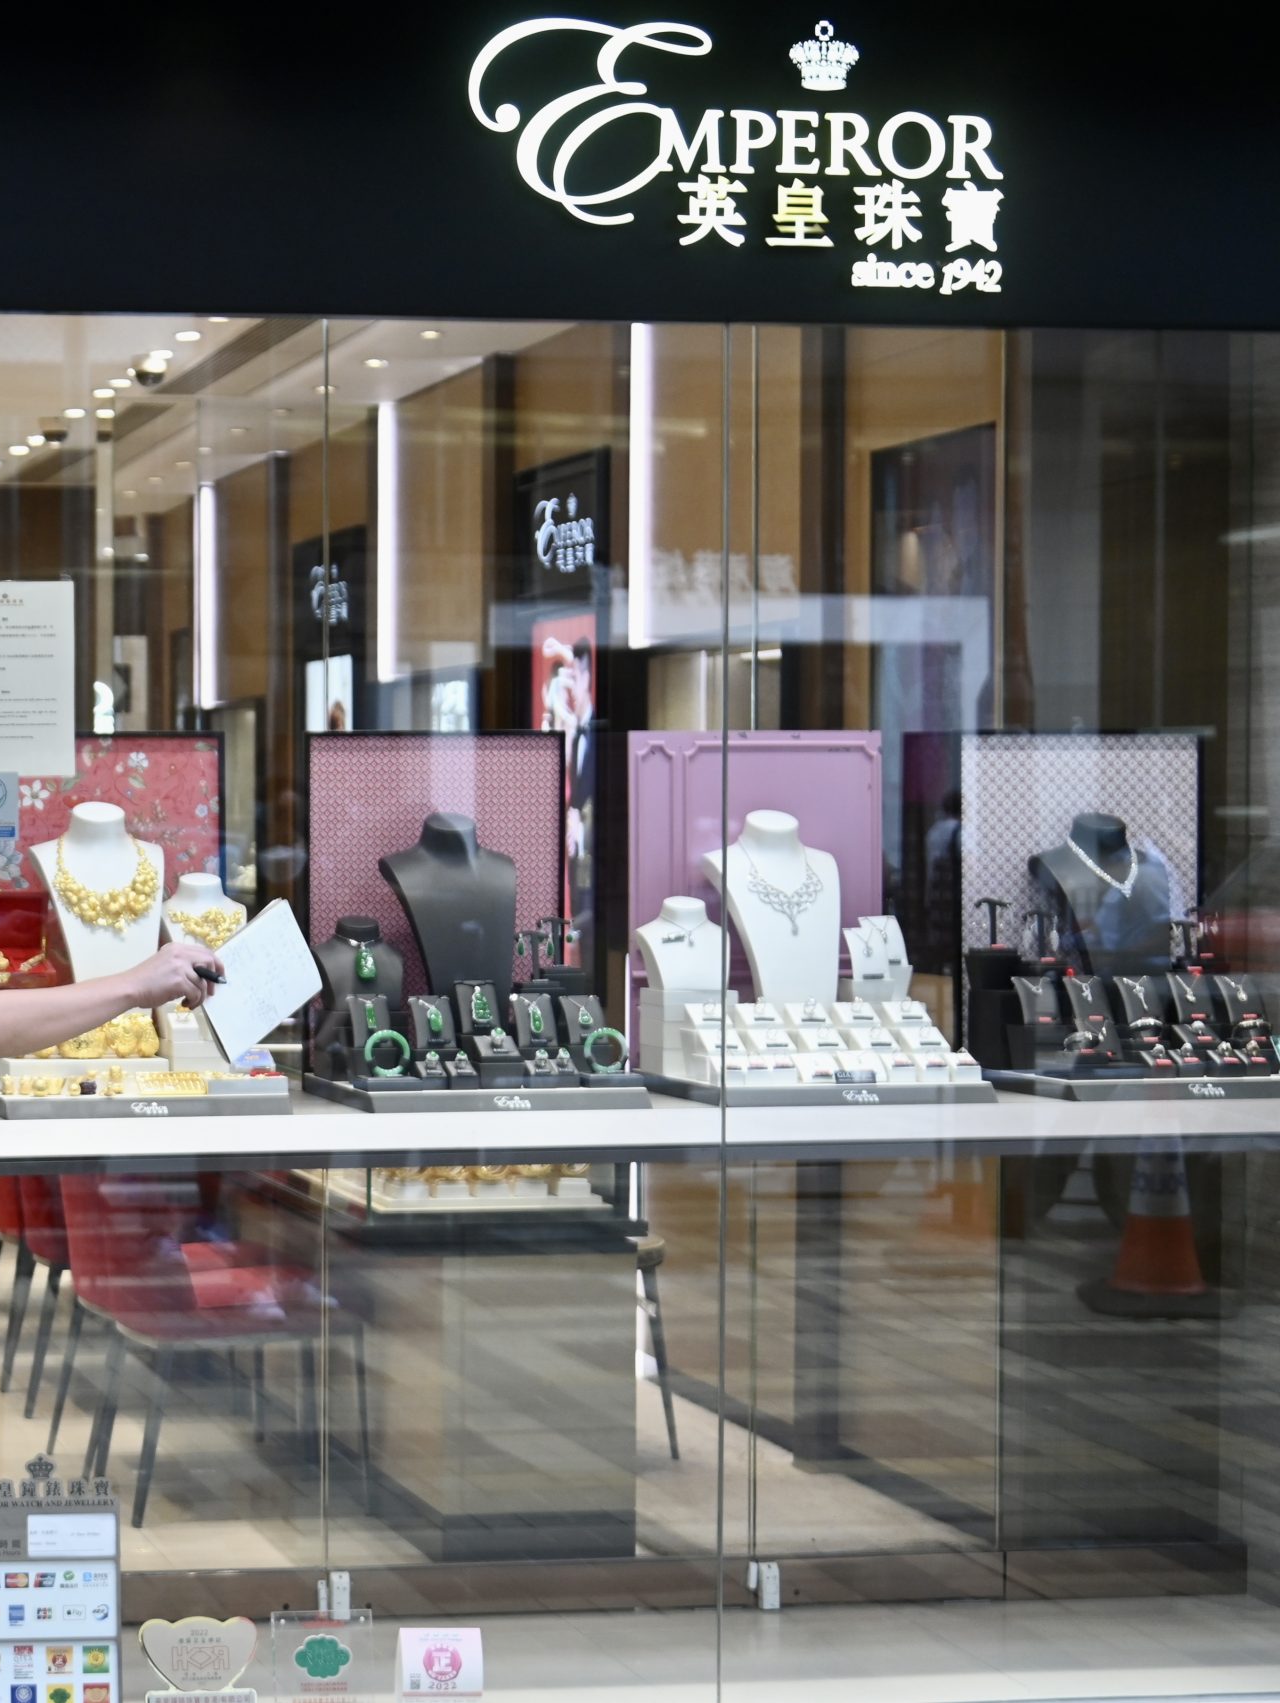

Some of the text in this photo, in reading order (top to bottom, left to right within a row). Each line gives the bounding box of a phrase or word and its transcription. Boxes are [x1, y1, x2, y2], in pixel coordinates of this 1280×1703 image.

[468, 17, 1004, 226] EMPEROR
[676, 174, 1005, 254] 英皇珠寶
[851, 252, 1002, 296] since 1942
[11, 1500, 43, 1508] WATCH
[44, 1499, 62, 1507] AND
[64, 1499, 116, 1507] JEWELLERY
[427, 1681, 458, 1690] 2022
